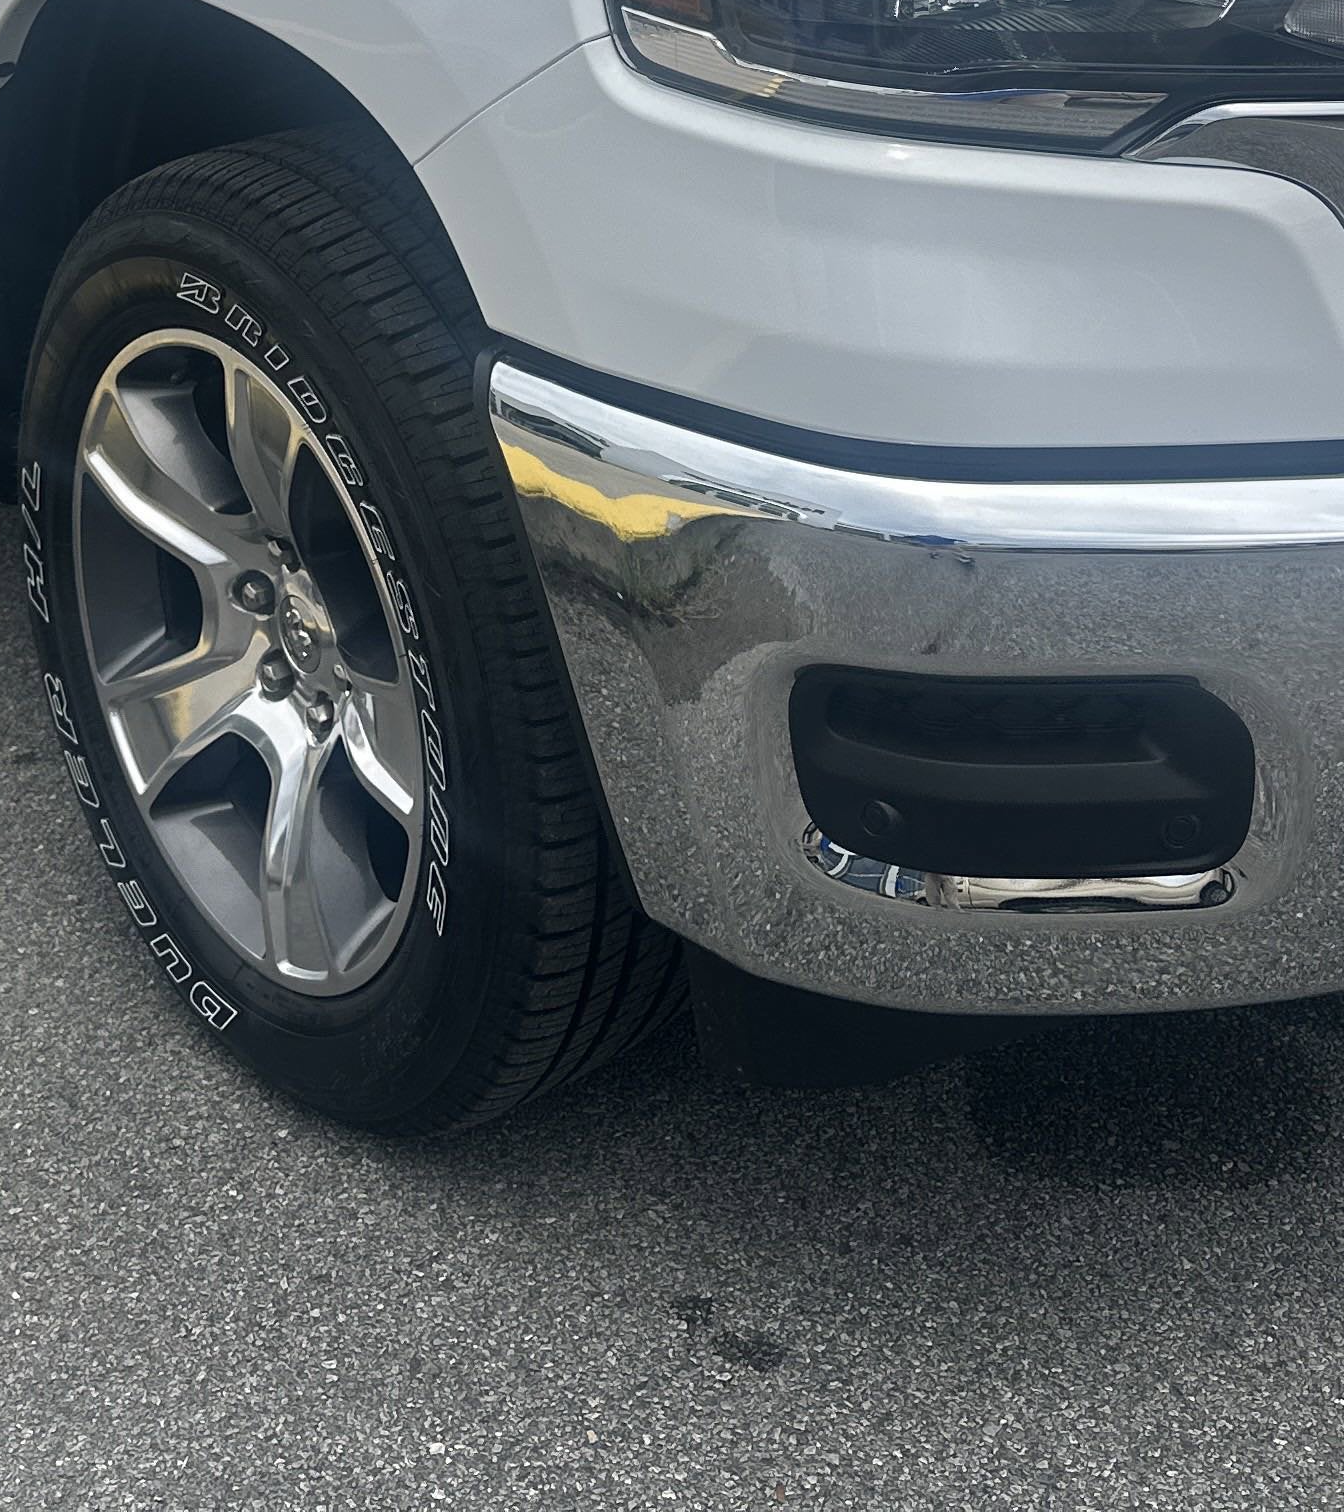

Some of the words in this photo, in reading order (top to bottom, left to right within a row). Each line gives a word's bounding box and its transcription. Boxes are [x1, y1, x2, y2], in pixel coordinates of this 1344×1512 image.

[21, 461, 50, 624] H/L
[176, 272, 450, 937] BRIDGESTONE
[44, 673, 238, 1032] DUELER
